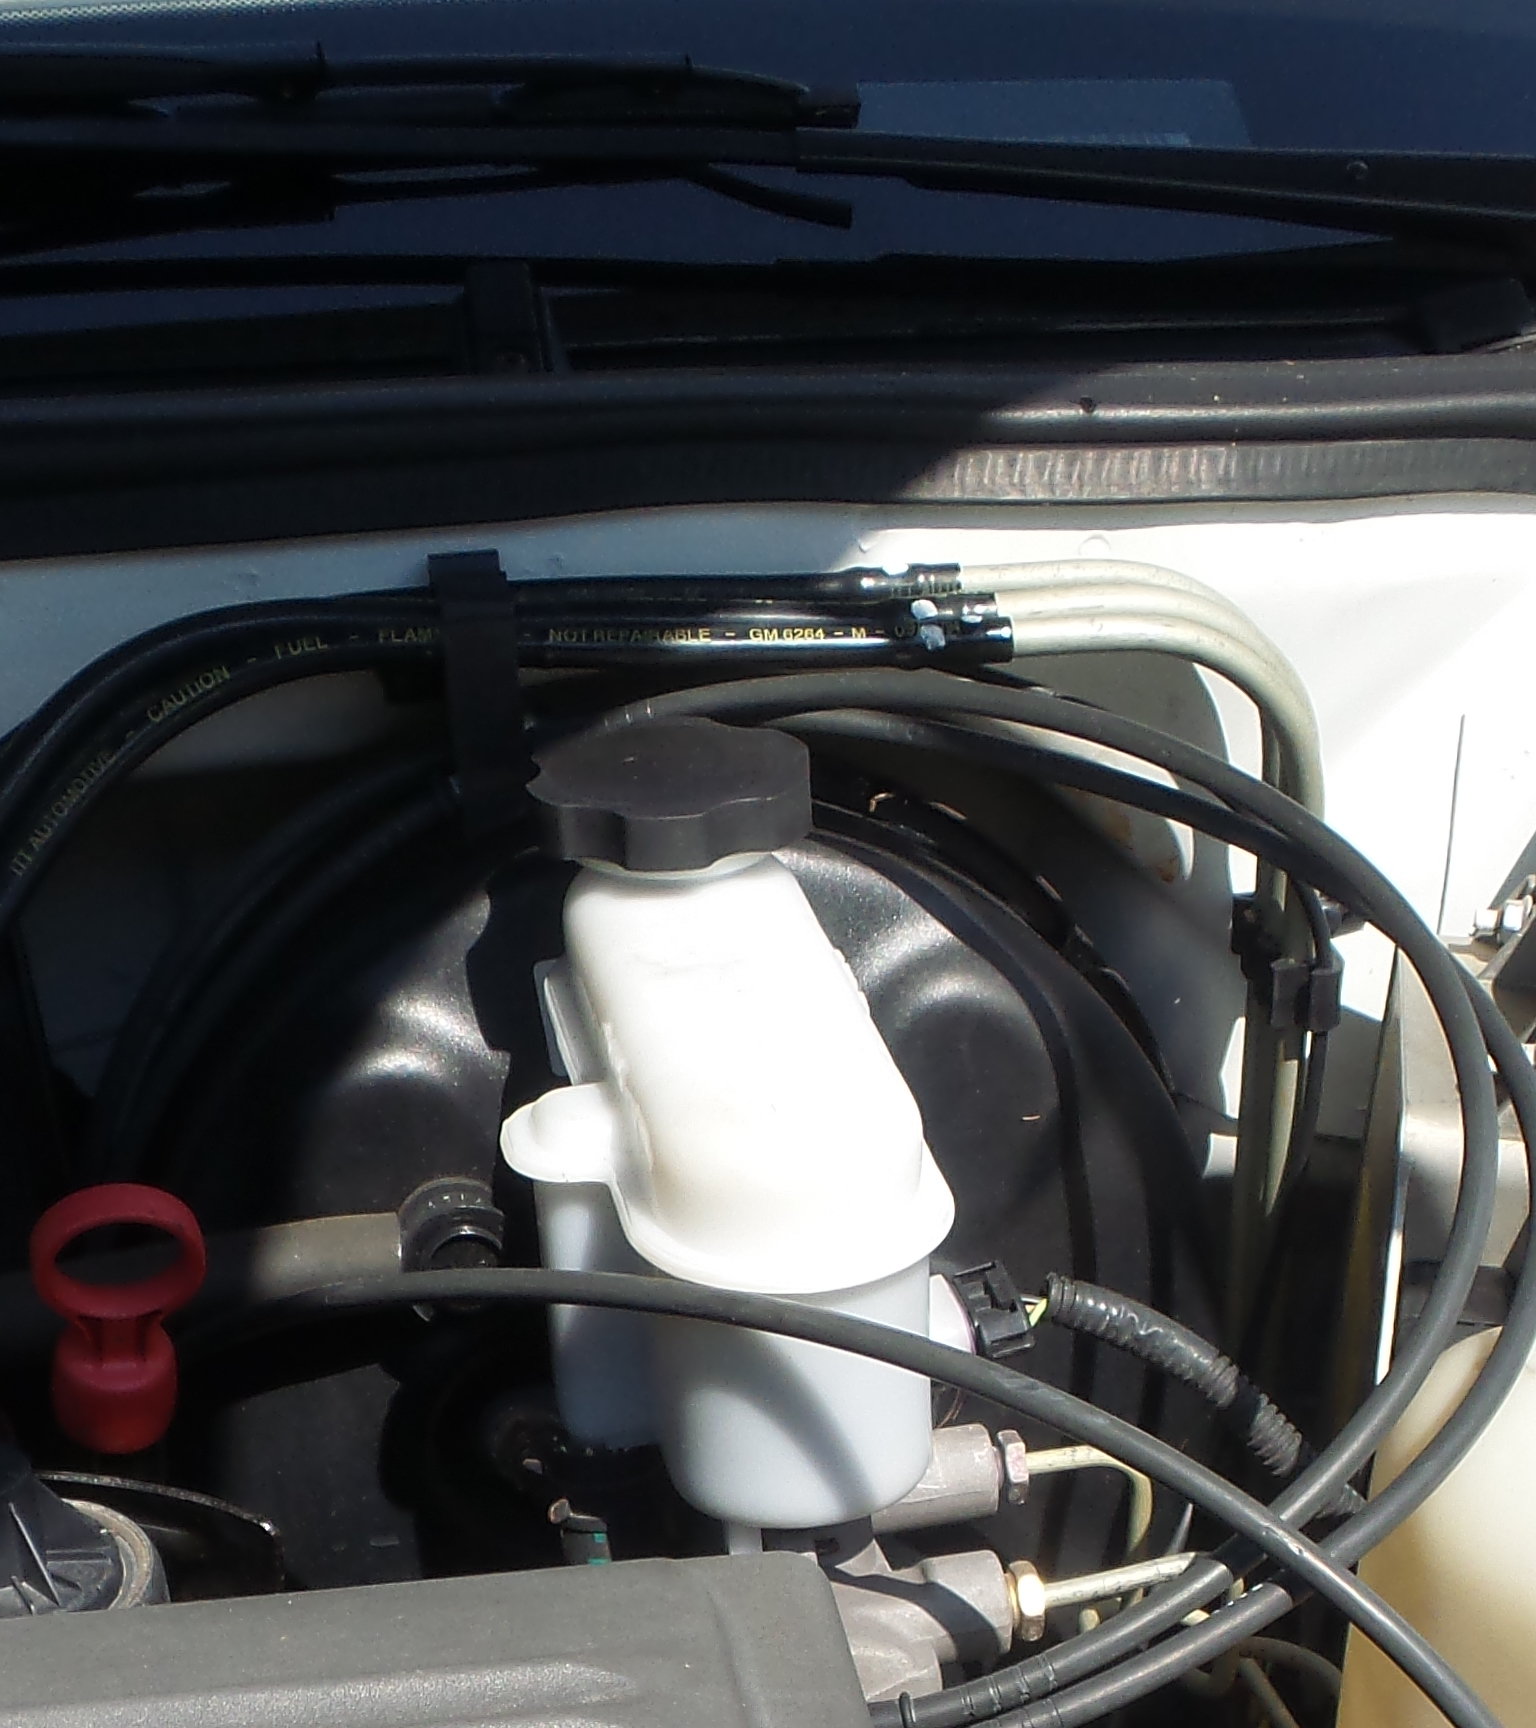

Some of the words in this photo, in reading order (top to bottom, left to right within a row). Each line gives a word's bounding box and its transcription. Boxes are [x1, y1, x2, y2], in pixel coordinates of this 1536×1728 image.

[147, 666, 231, 723] CAUTION
[749, 628, 779, 642] GM
[783, 627, 826, 641] 6264
[852, 627, 866, 639] M
